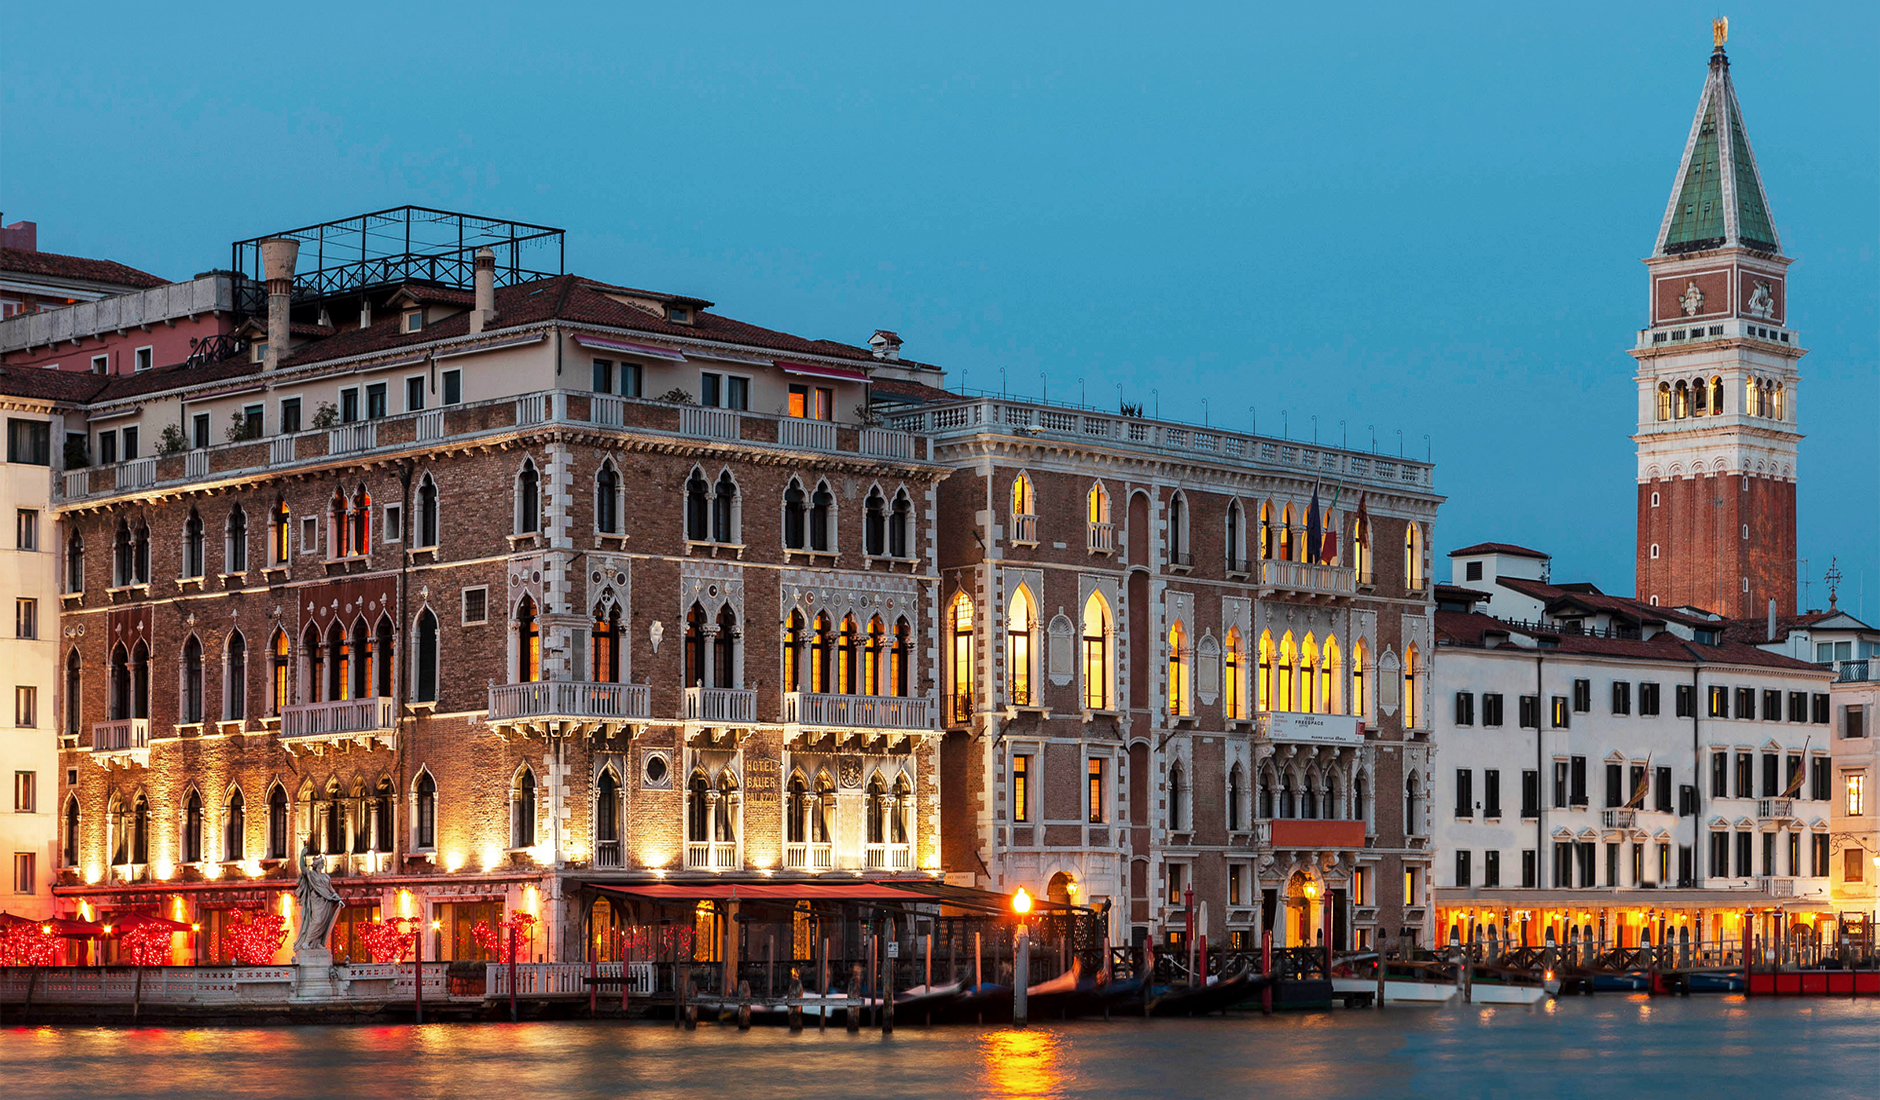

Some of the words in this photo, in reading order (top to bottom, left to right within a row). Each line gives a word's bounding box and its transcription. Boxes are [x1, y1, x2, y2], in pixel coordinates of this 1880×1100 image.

[746, 760, 775, 772] HOTEL
[746, 776, 776, 788] BAUER
[745, 792, 778, 802] PALAZZO
